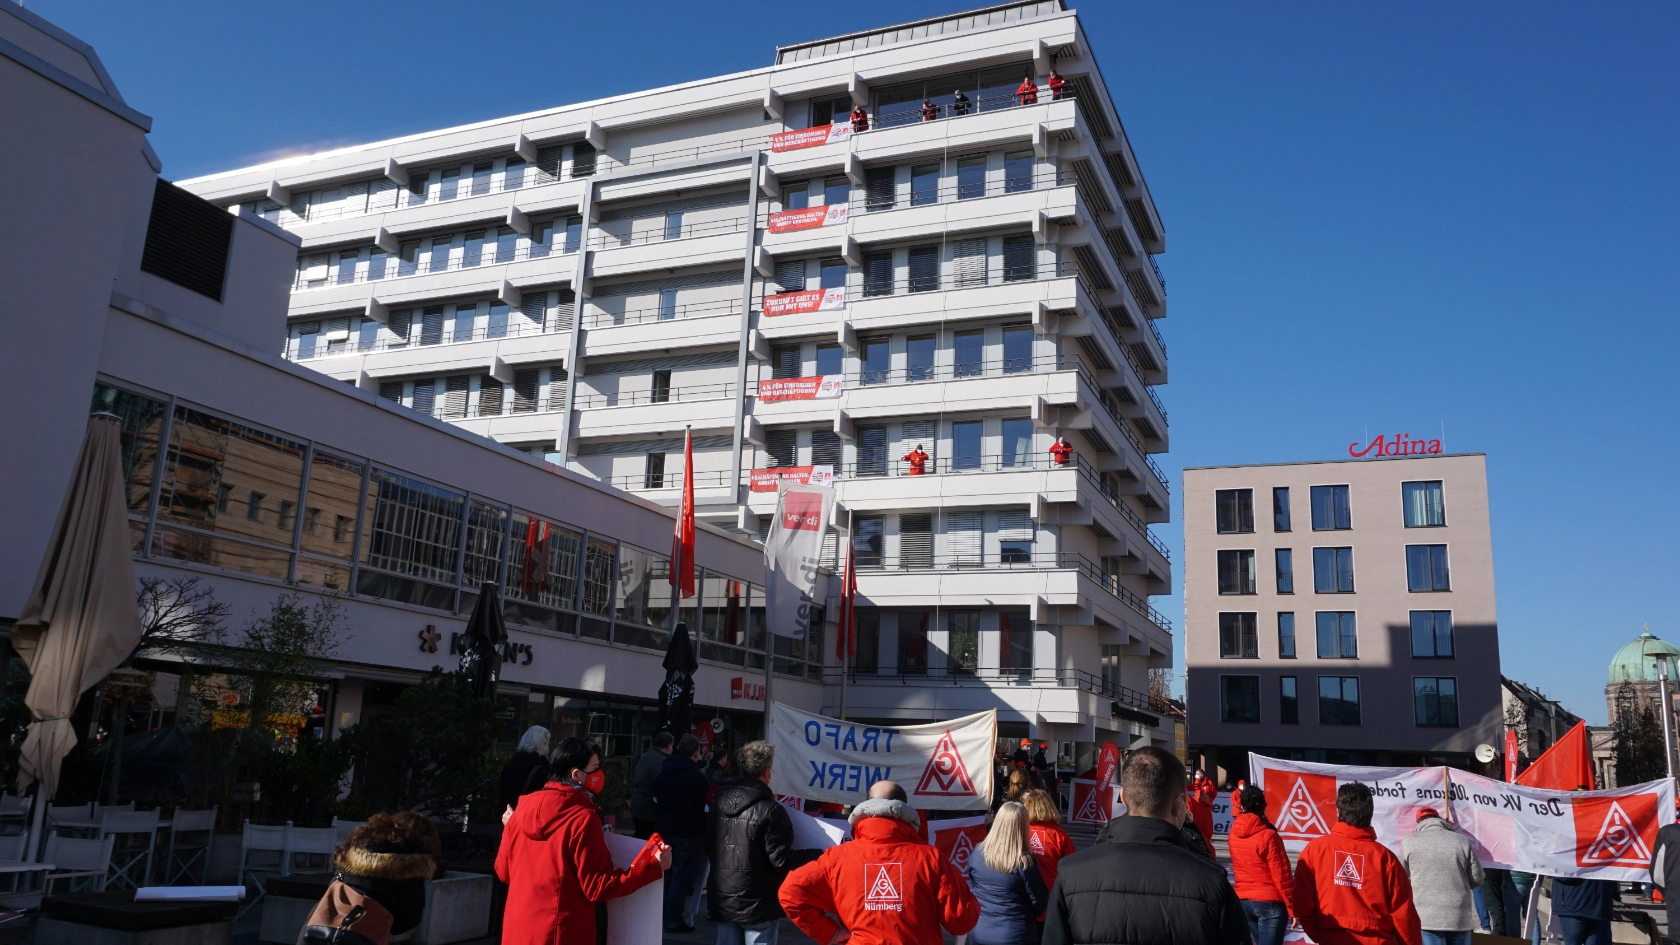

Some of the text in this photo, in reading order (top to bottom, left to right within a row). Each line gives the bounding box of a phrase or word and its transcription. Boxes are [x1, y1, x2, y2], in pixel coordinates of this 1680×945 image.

[766, 297, 795, 307] ZUKUNFT
[812, 293, 820, 301] ES
[771, 301, 814, 312] NUR MIT UNS!
[1348, 432, 1443, 457] Adina
[1333, 878, 1363, 890] Nürnberg
[864, 902, 903, 912] Nürnberg
